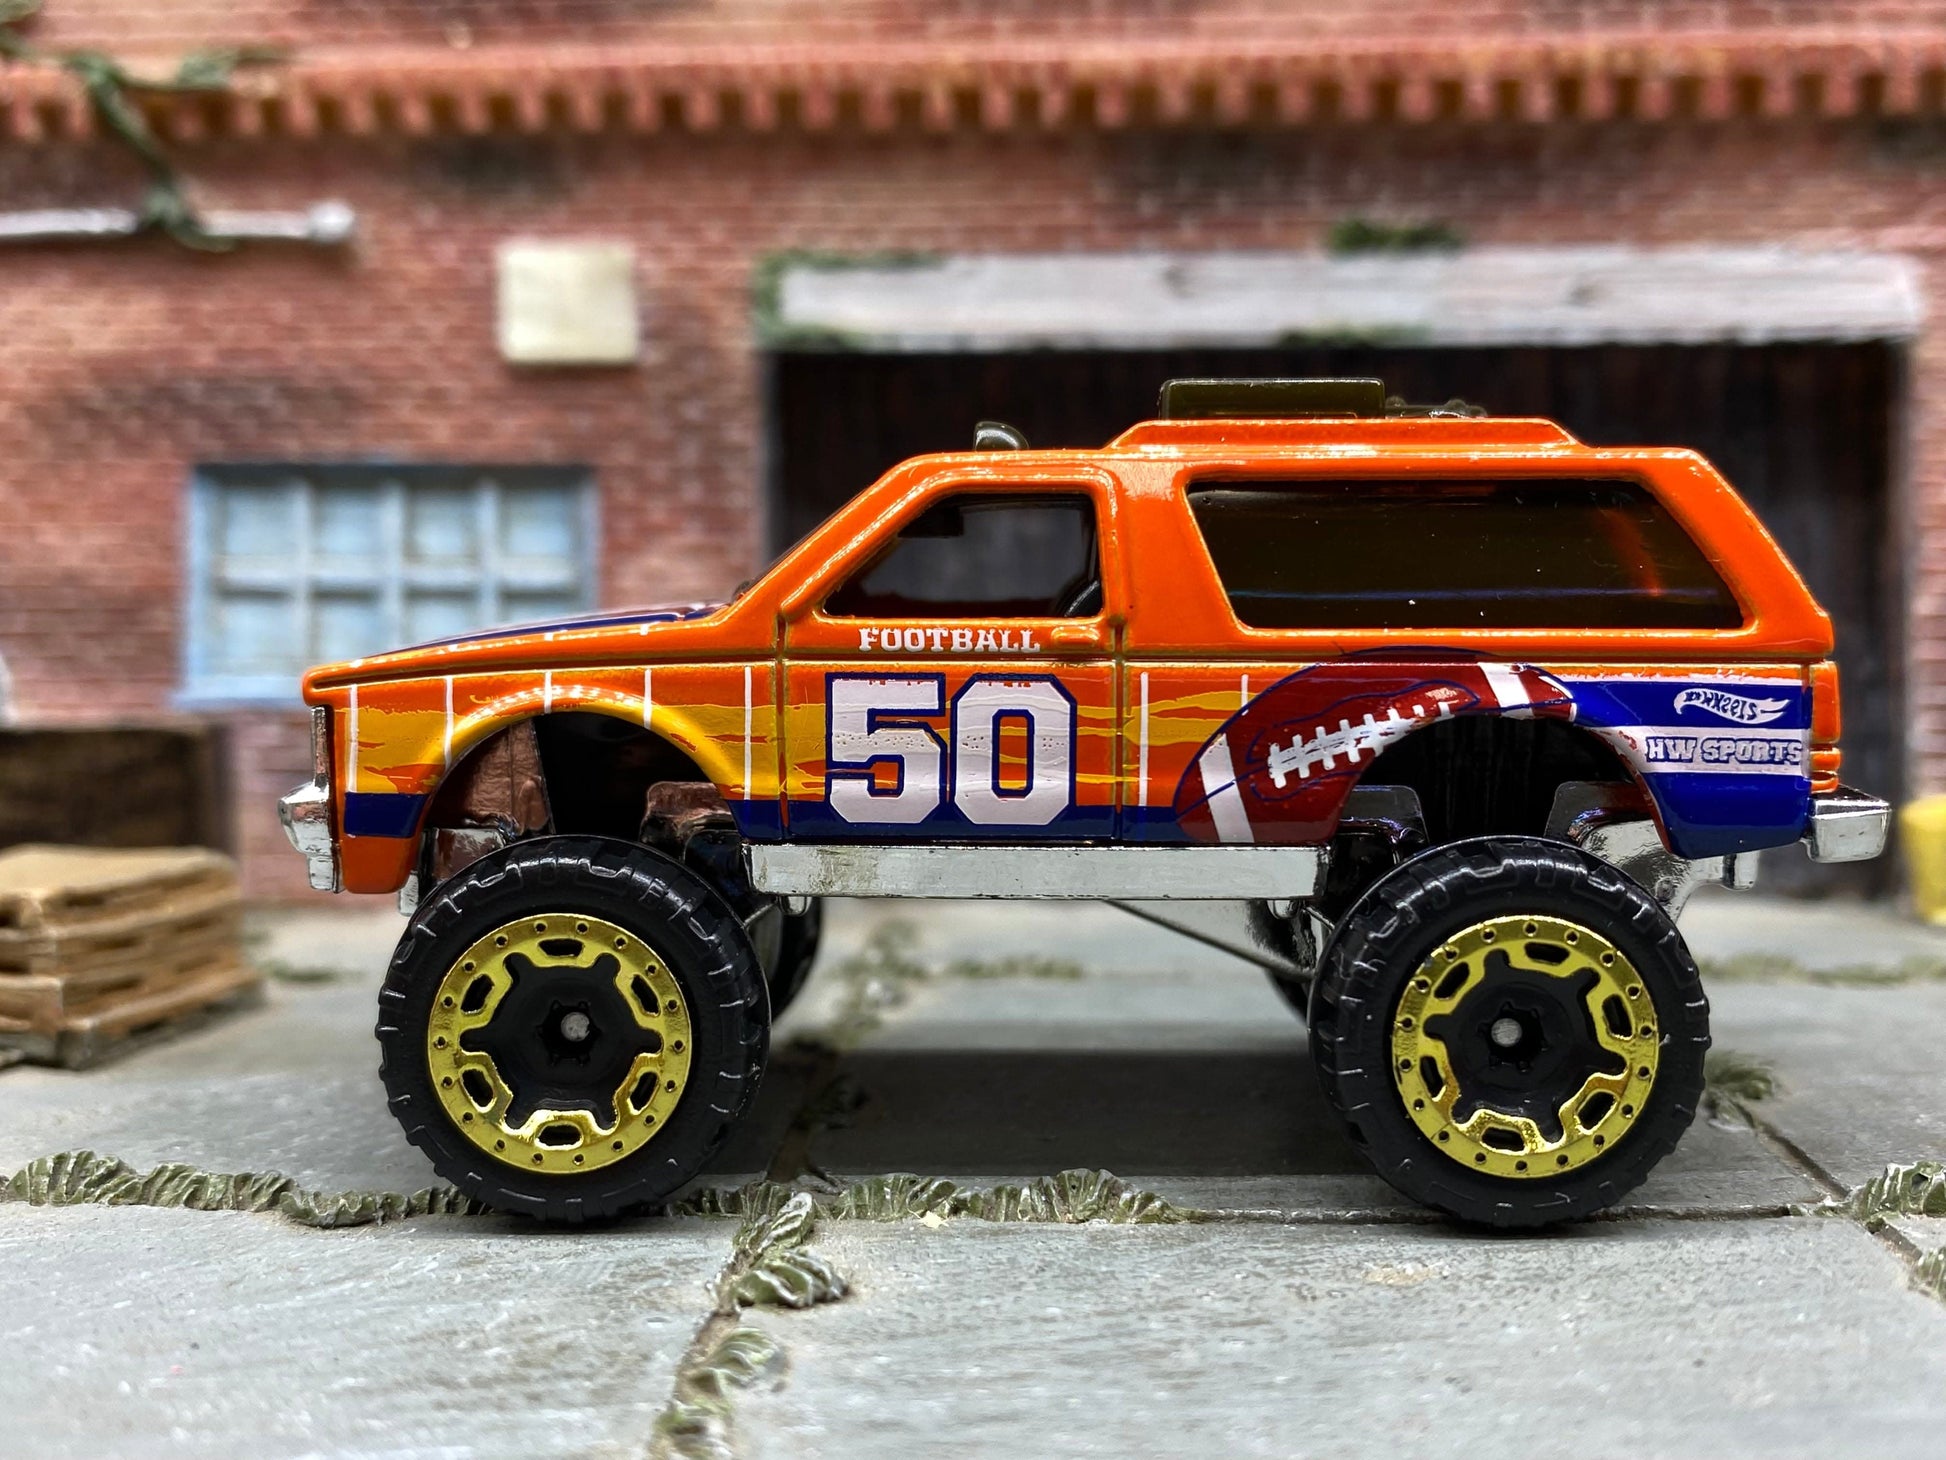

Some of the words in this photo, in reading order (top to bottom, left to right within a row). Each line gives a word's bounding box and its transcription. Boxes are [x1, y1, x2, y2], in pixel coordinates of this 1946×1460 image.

[858, 627, 1040, 652] FOOTBALL
[826, 673, 1077, 825] 50
[1646, 737, 1698, 763] HW
[1701, 738, 1803, 765] SPORTS
